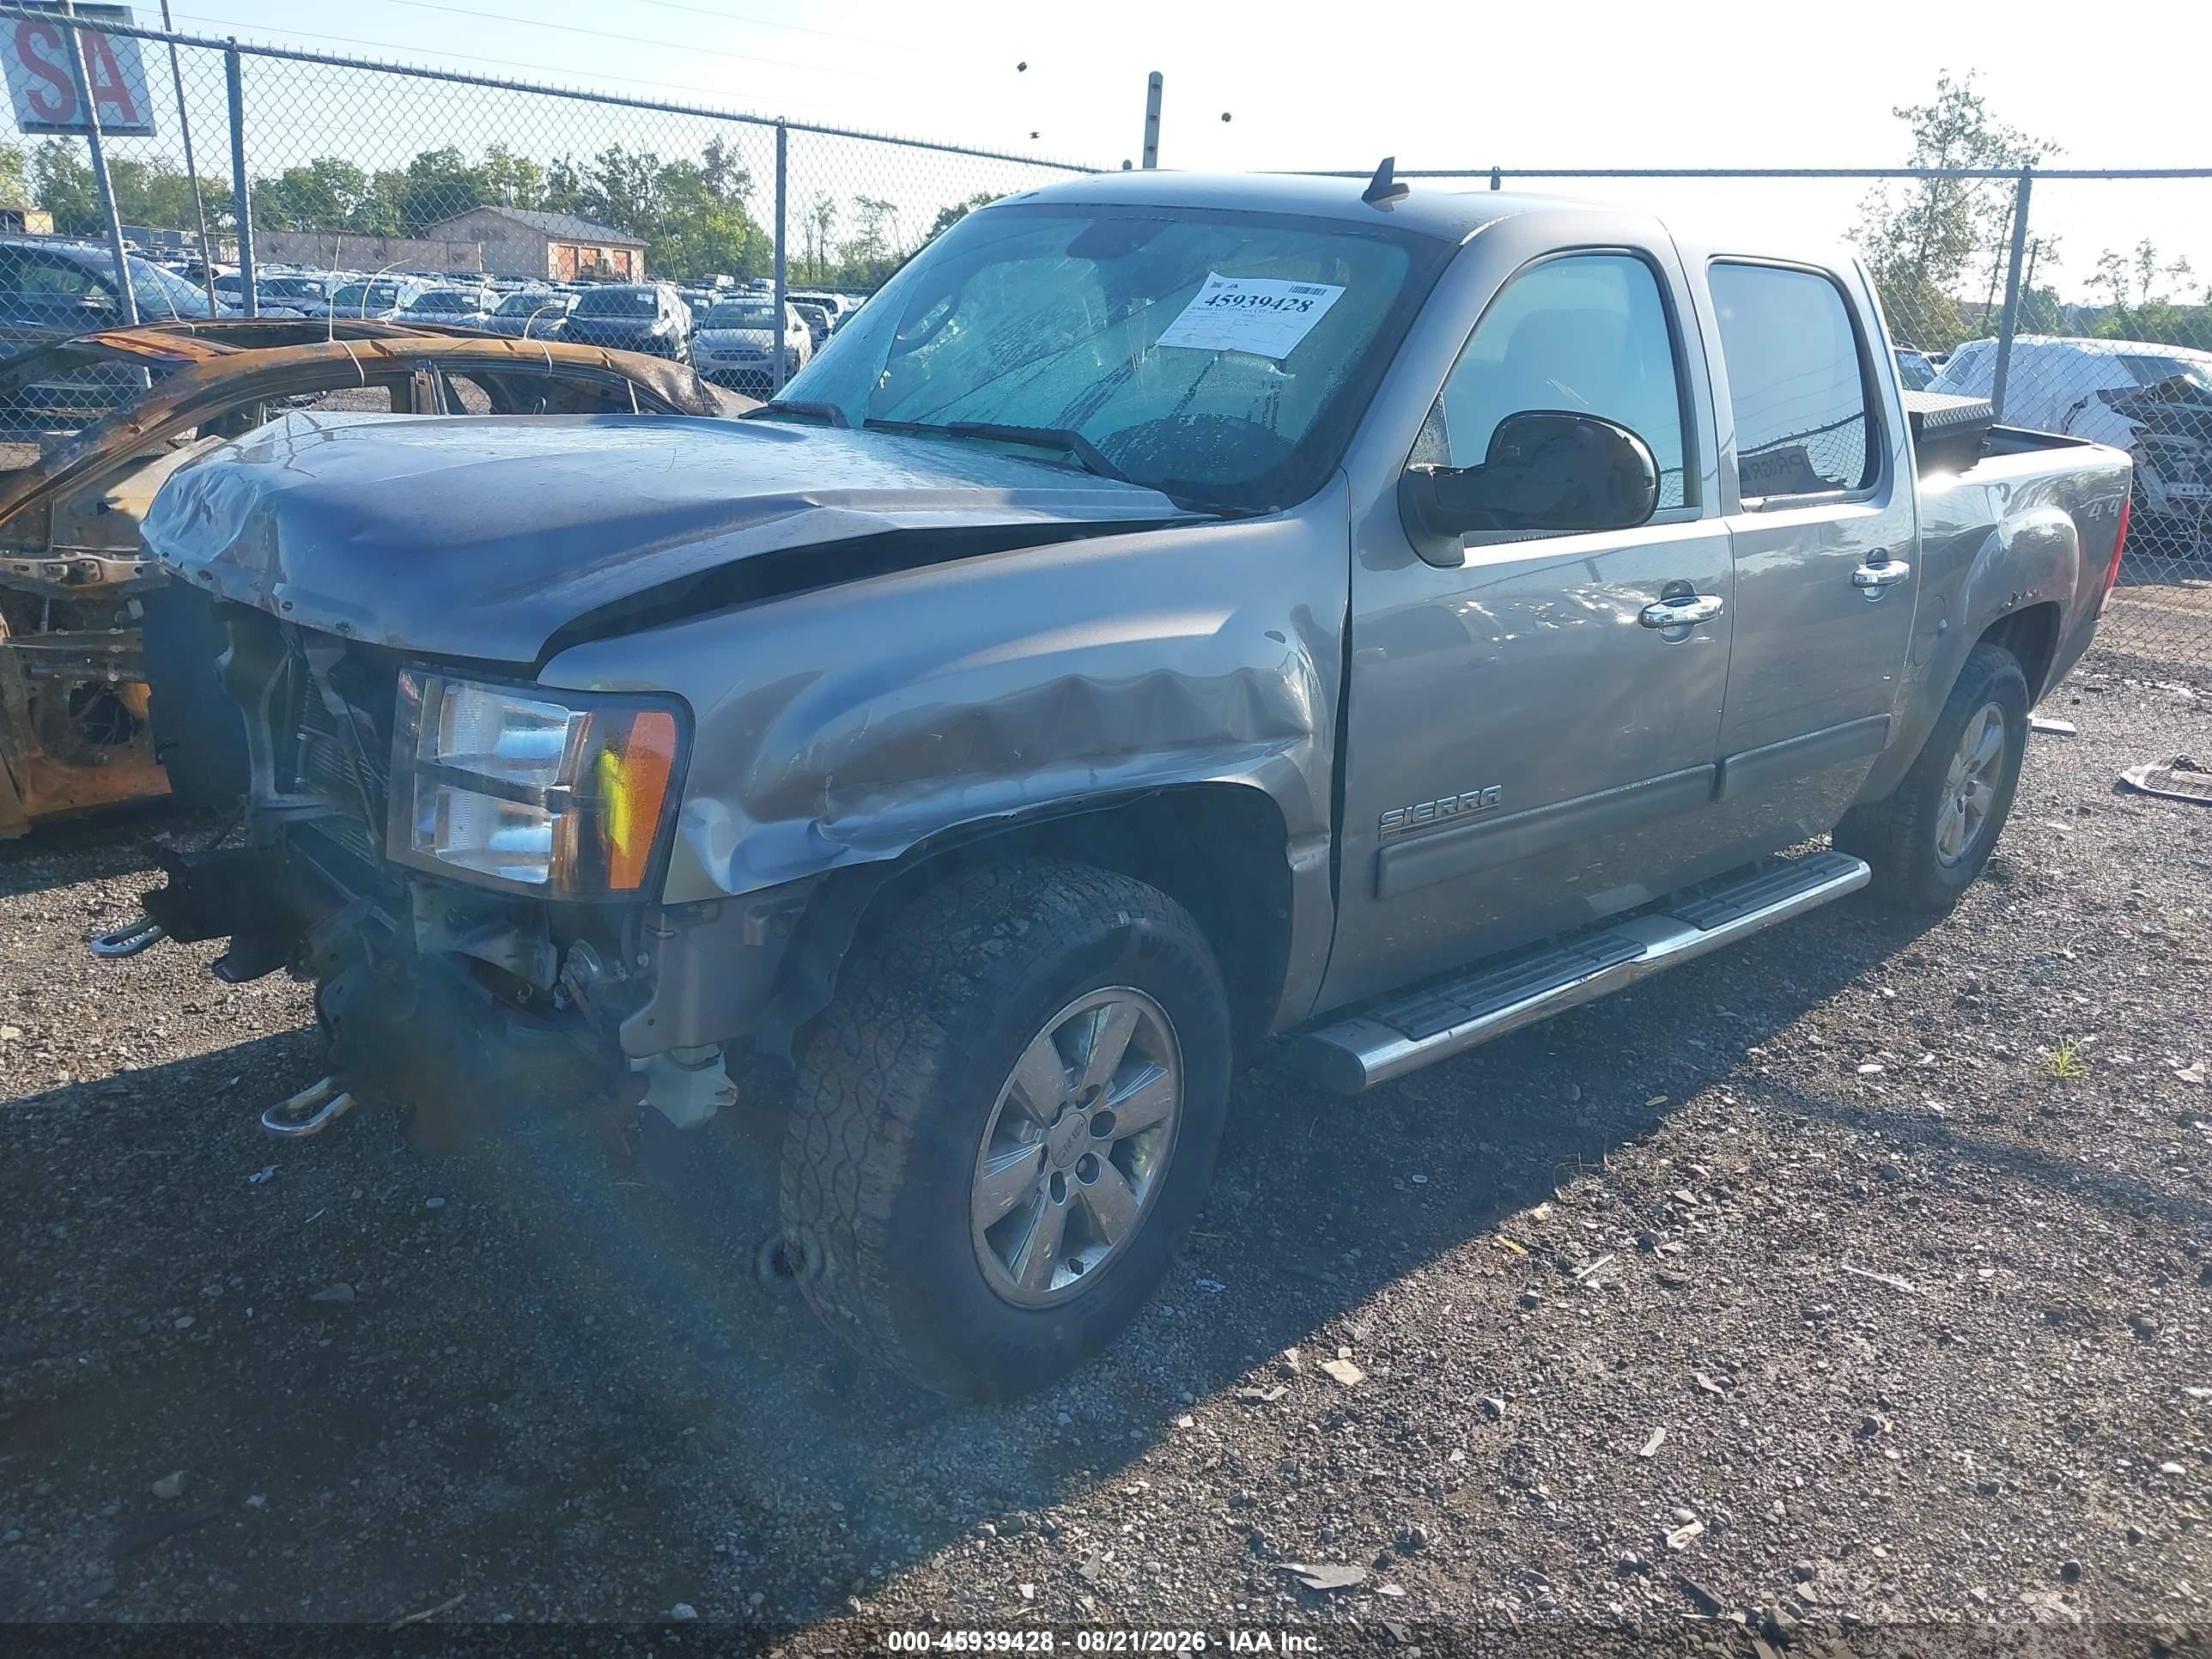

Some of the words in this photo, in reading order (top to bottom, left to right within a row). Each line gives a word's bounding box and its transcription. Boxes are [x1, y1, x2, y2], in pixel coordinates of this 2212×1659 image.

[15, 20, 140, 124] SA
[1204, 293, 1314, 313] 45939428
[1379, 785, 1502, 828] SIERRA
